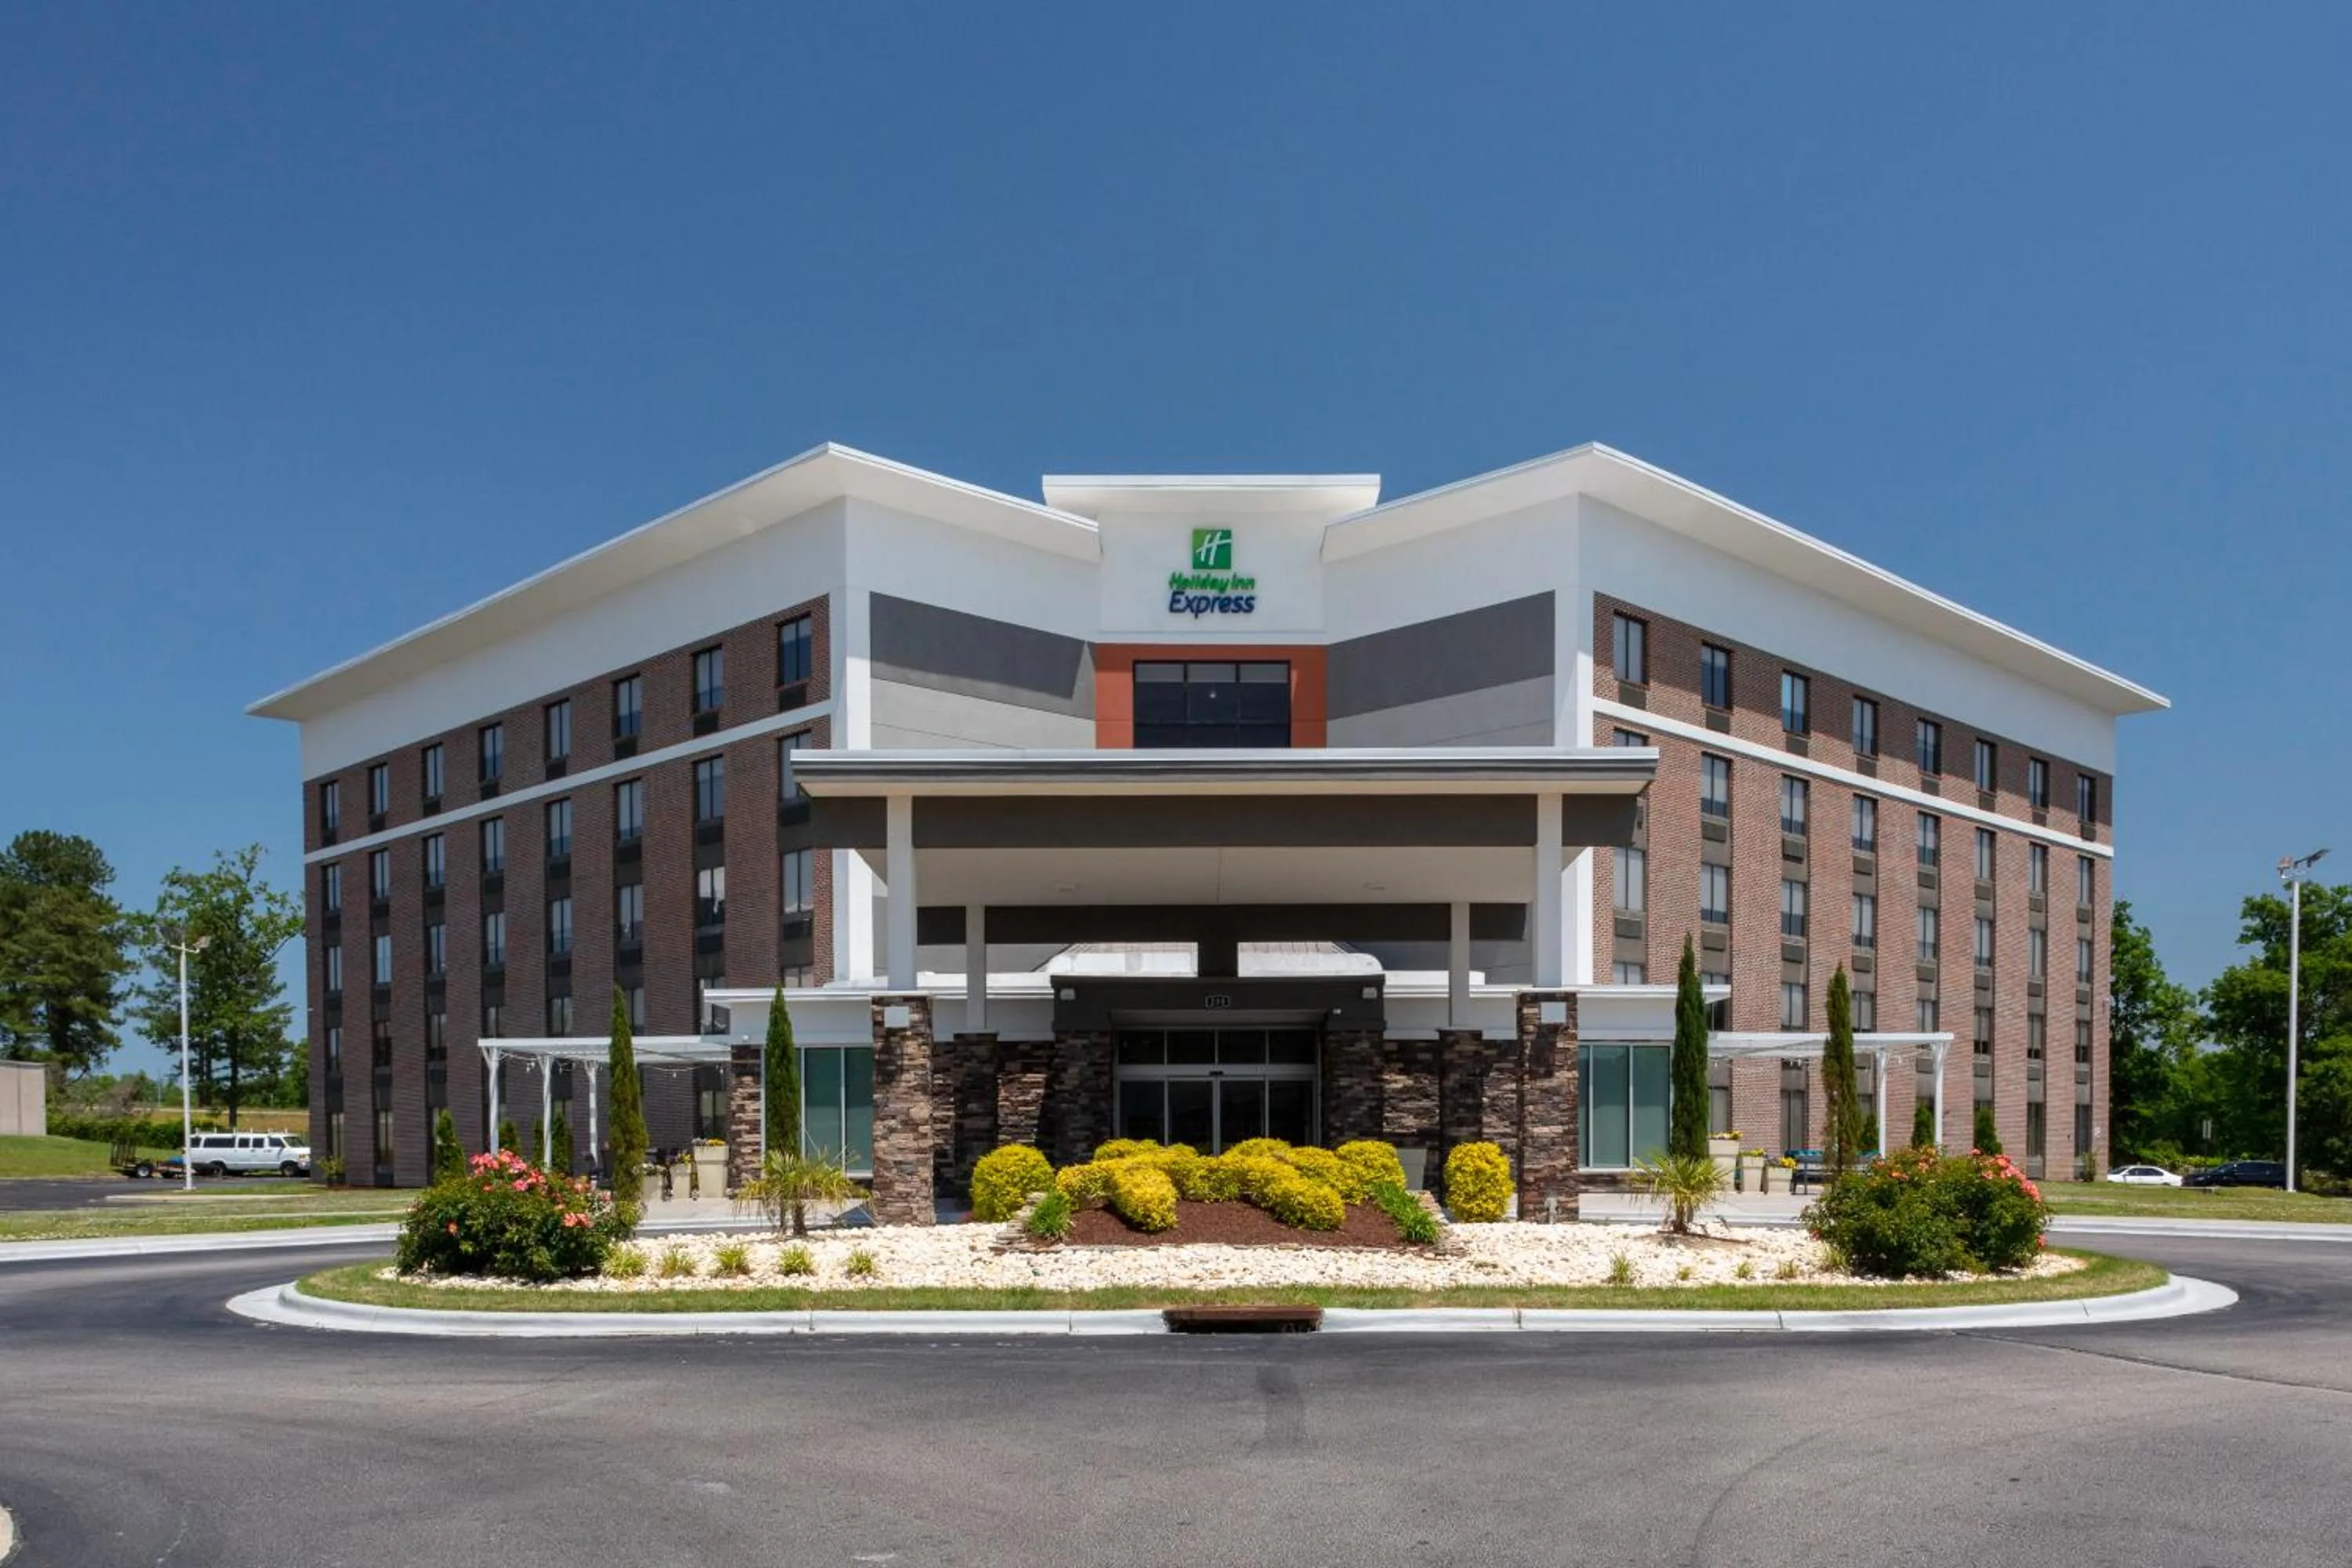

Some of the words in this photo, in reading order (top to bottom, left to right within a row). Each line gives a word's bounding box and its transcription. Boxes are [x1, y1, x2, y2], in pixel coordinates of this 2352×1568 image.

[1169, 572, 1229, 593] Holiday
[1231, 572, 1255, 590] Inn
[1169, 590, 1256, 619] Express
